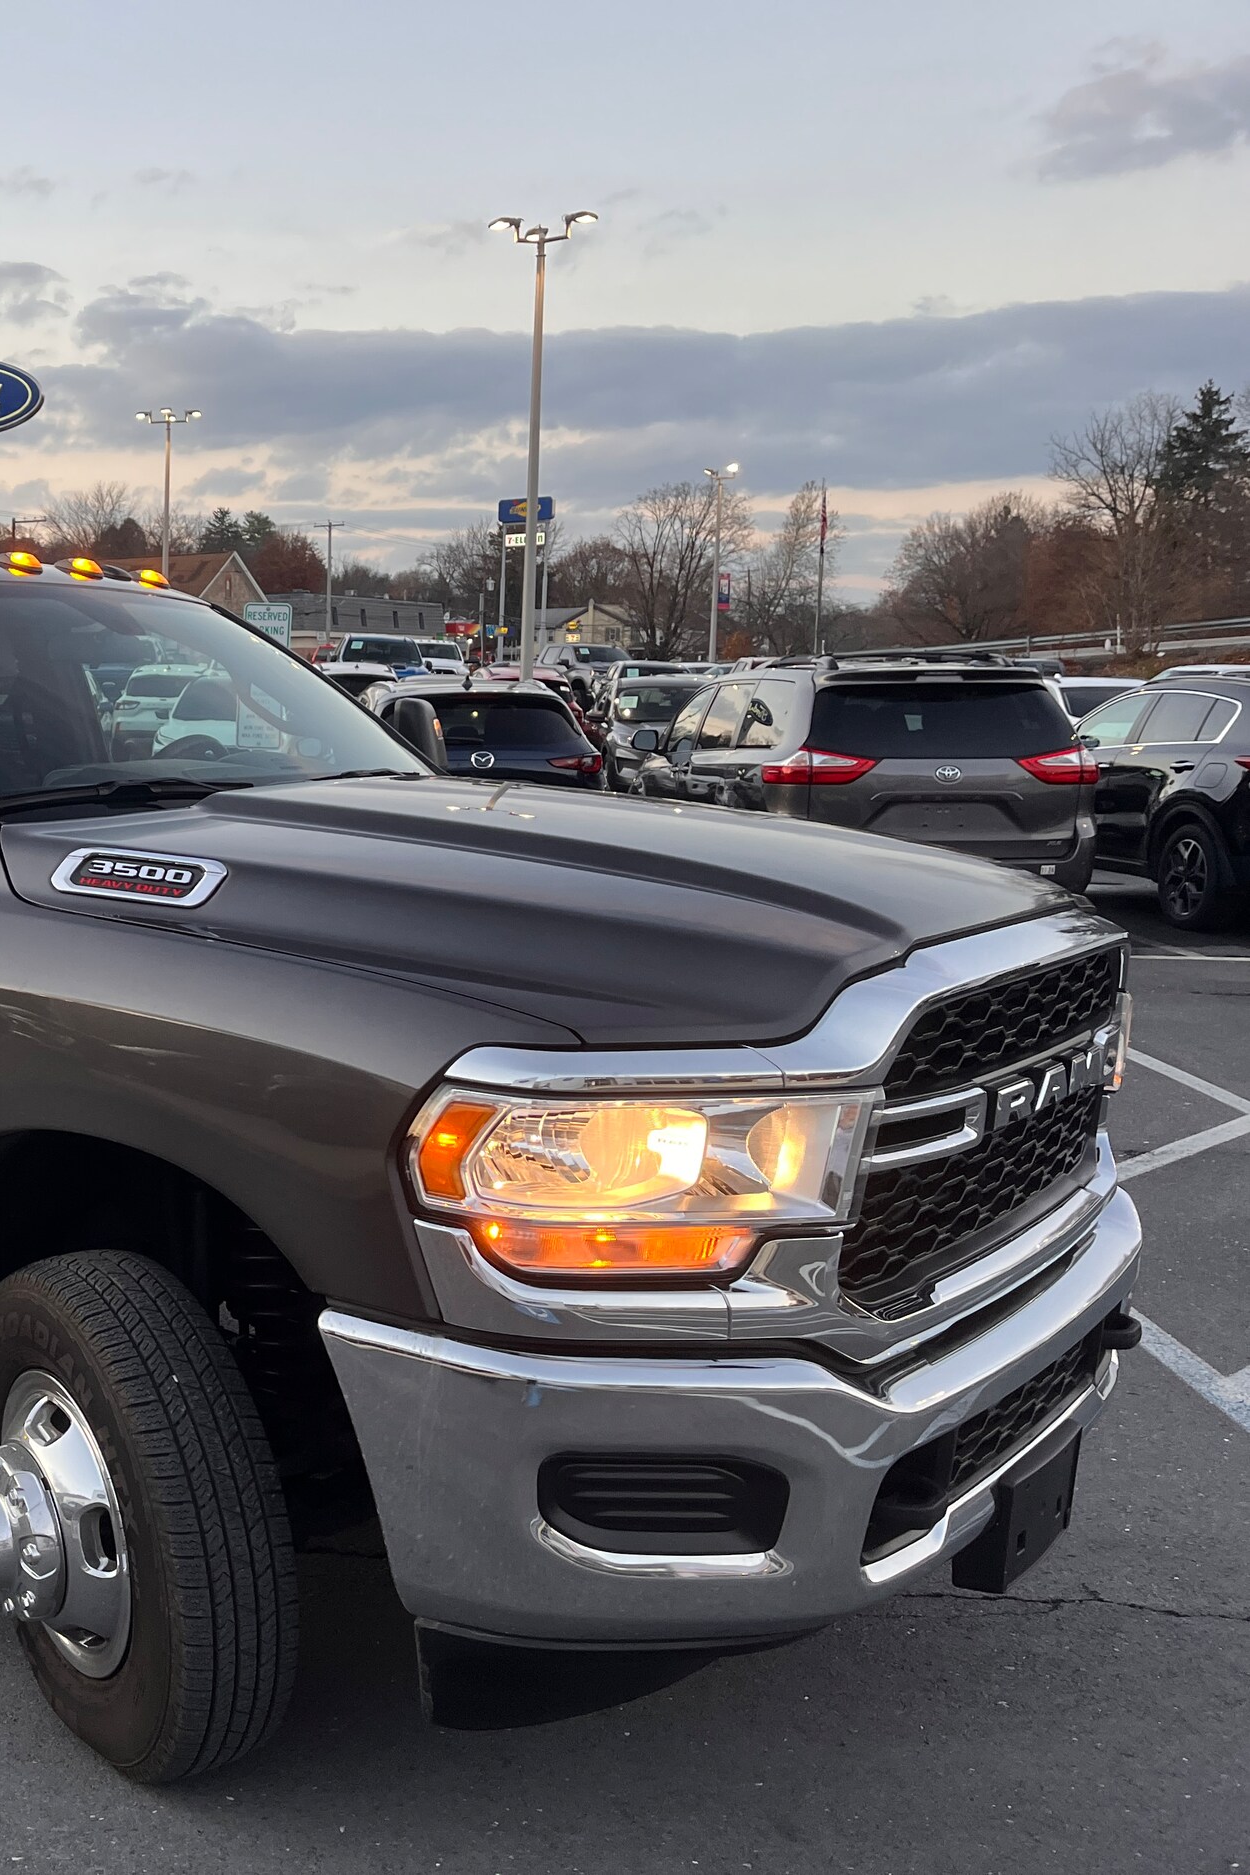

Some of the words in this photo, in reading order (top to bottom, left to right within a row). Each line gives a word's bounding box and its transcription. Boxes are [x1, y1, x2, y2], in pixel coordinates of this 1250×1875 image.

[247, 611, 288, 621] RESERVED
[88, 860, 193, 884] 3500
[79, 877, 134, 891] HEAVY
[135, 883, 185, 897] DUTY
[993, 1045, 1105, 1131] RAM
